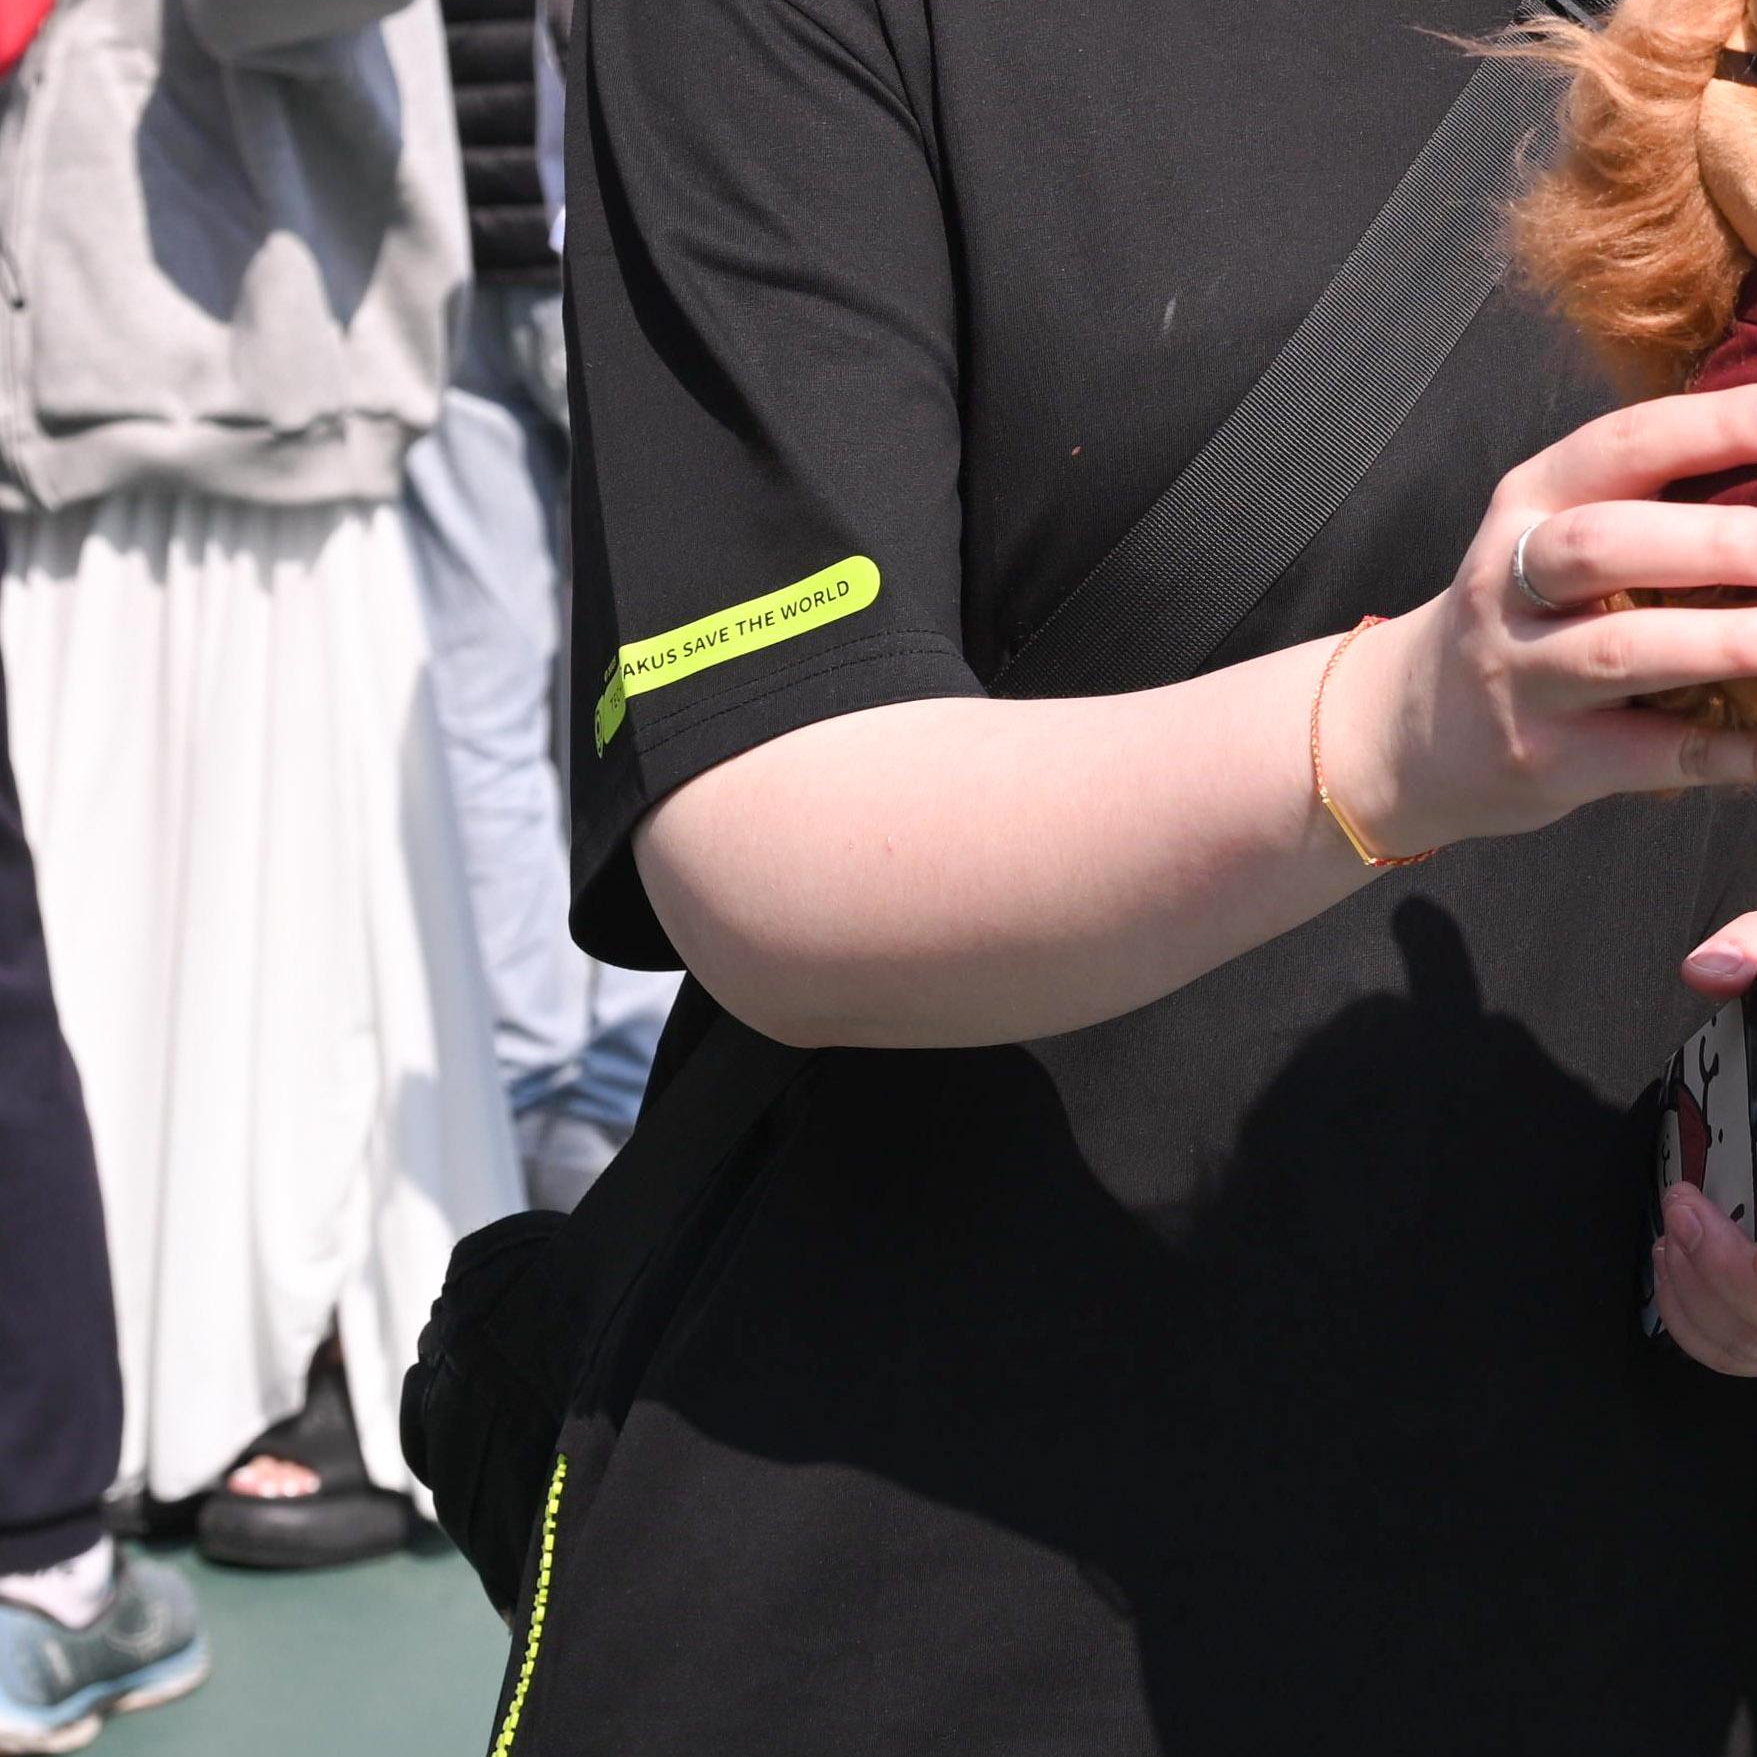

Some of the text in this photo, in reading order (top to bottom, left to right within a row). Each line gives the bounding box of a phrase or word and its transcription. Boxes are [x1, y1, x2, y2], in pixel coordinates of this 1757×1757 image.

[683, 626, 730, 657] SAVE
[735, 610, 775, 636] THE
[780, 580, 849, 620] WORLD
